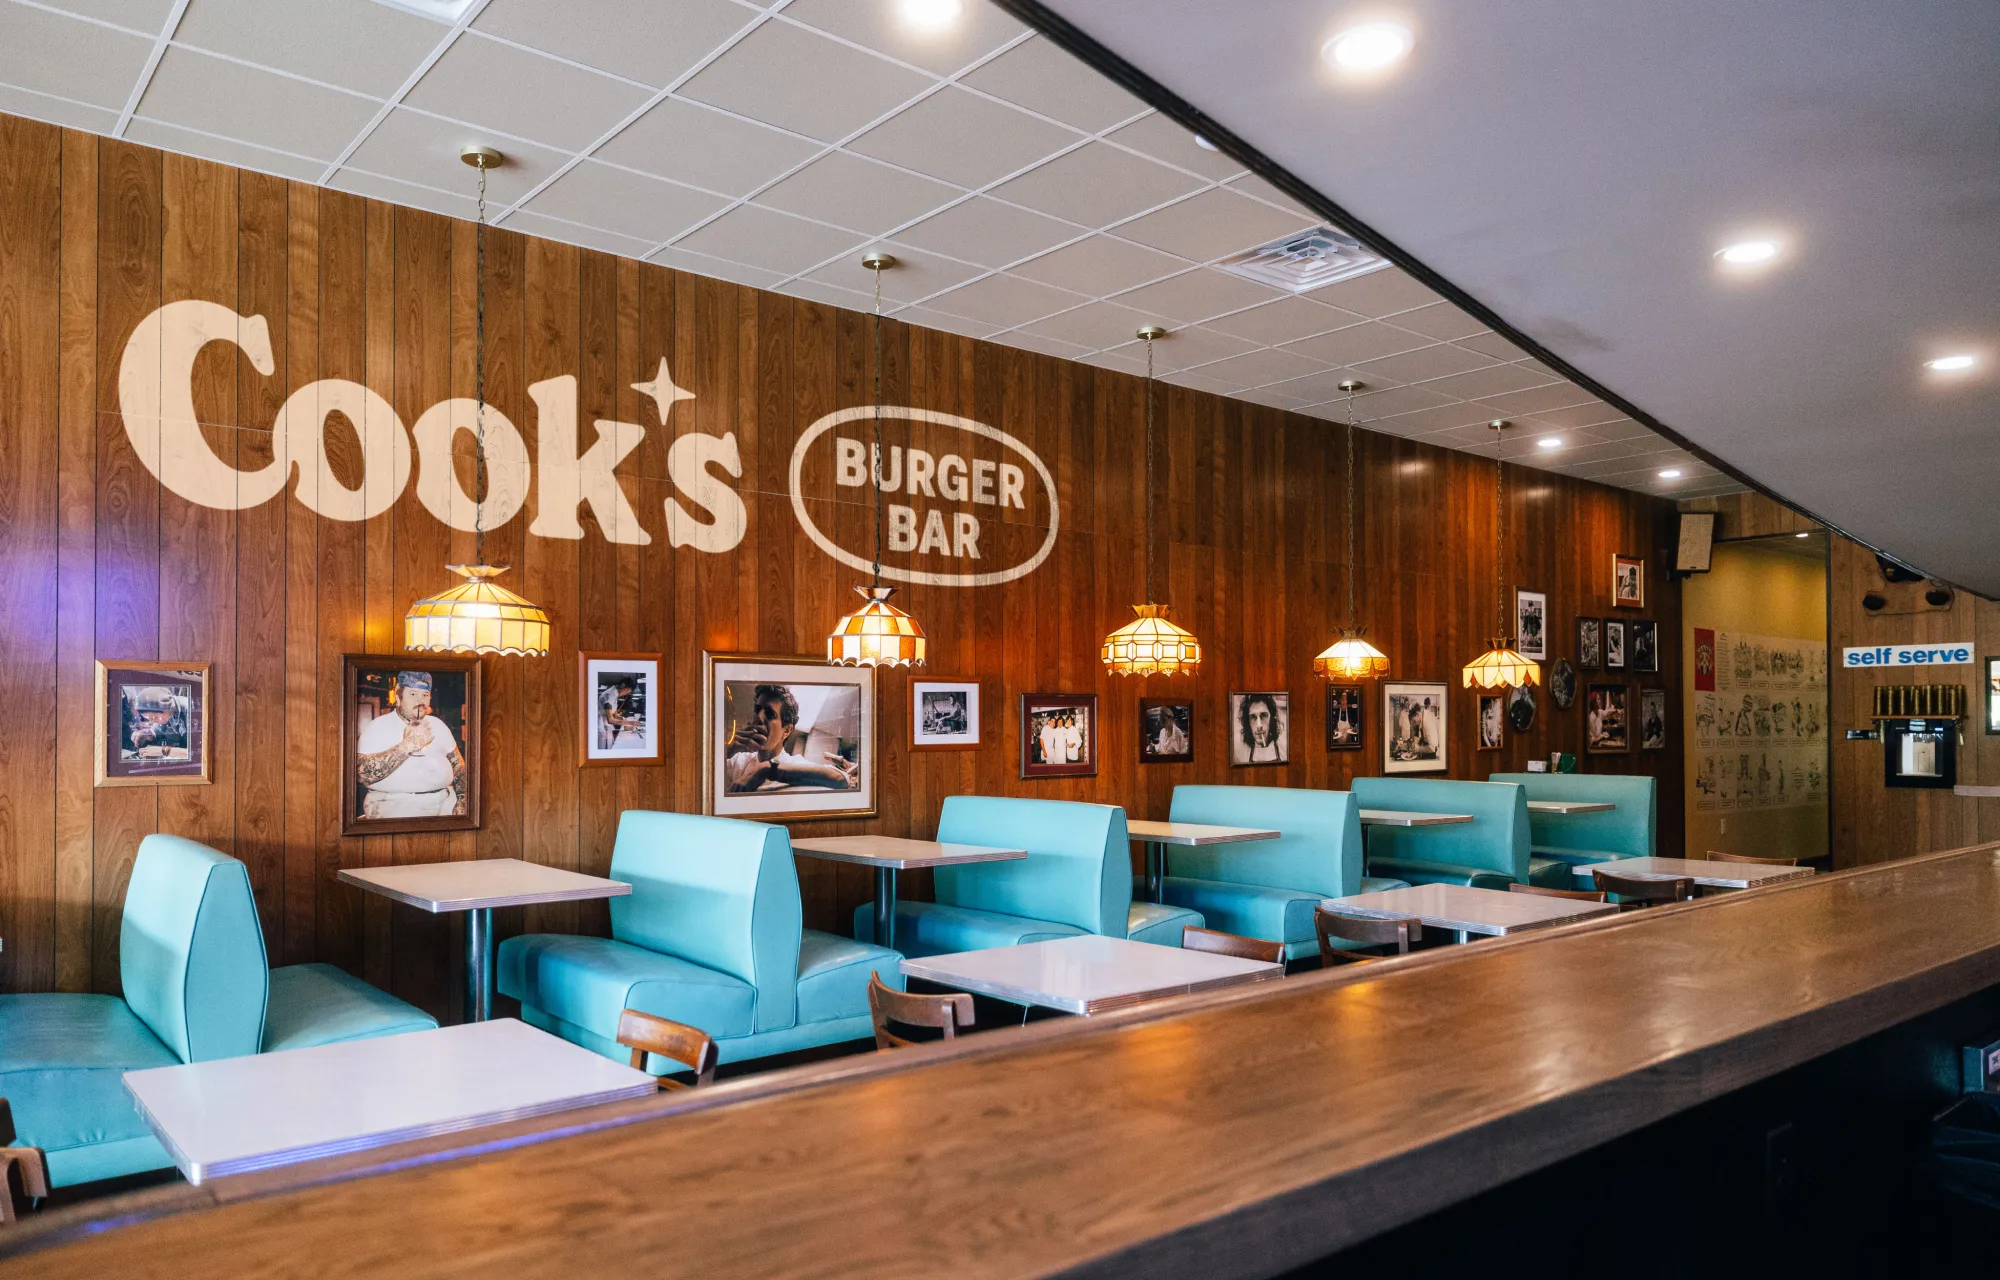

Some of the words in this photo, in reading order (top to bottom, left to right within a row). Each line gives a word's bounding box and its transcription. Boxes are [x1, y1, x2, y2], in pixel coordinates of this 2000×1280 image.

[118, 299, 748, 554] Cook's
[836, 436, 1026, 510] BURGER
[888, 503, 981, 559] BAR
[1847, 647, 1893, 666] self
[1898, 648, 1970, 664] serve
